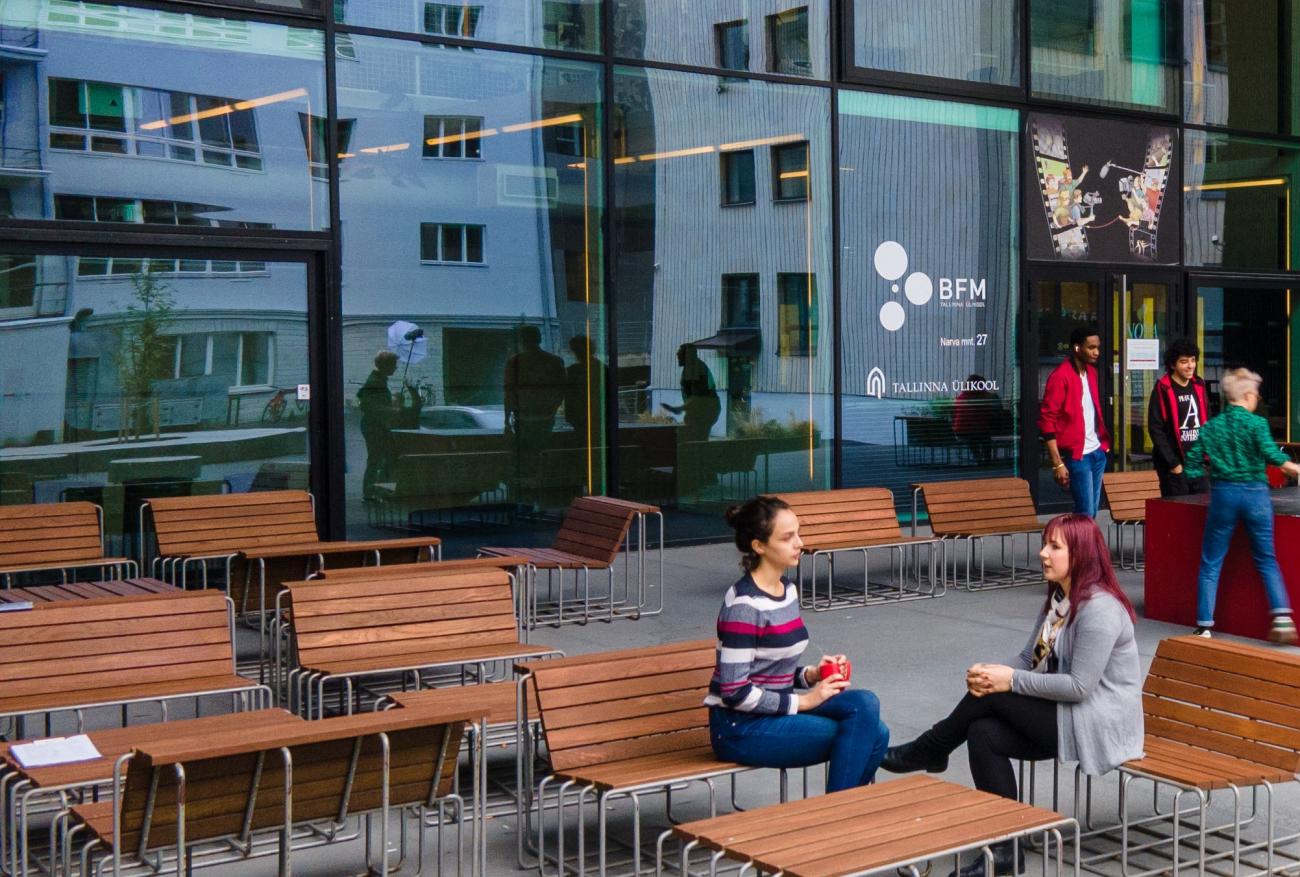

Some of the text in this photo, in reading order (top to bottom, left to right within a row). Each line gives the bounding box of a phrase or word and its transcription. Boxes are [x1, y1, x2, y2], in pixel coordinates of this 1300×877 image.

[940, 278, 986, 300] BFM
[940, 337, 960, 346] Narva
[976, 333, 988, 346] 27
[892, 379, 1000, 393] TALLINNA ÜLIKOOL
[1179, 394, 1200, 430] A
